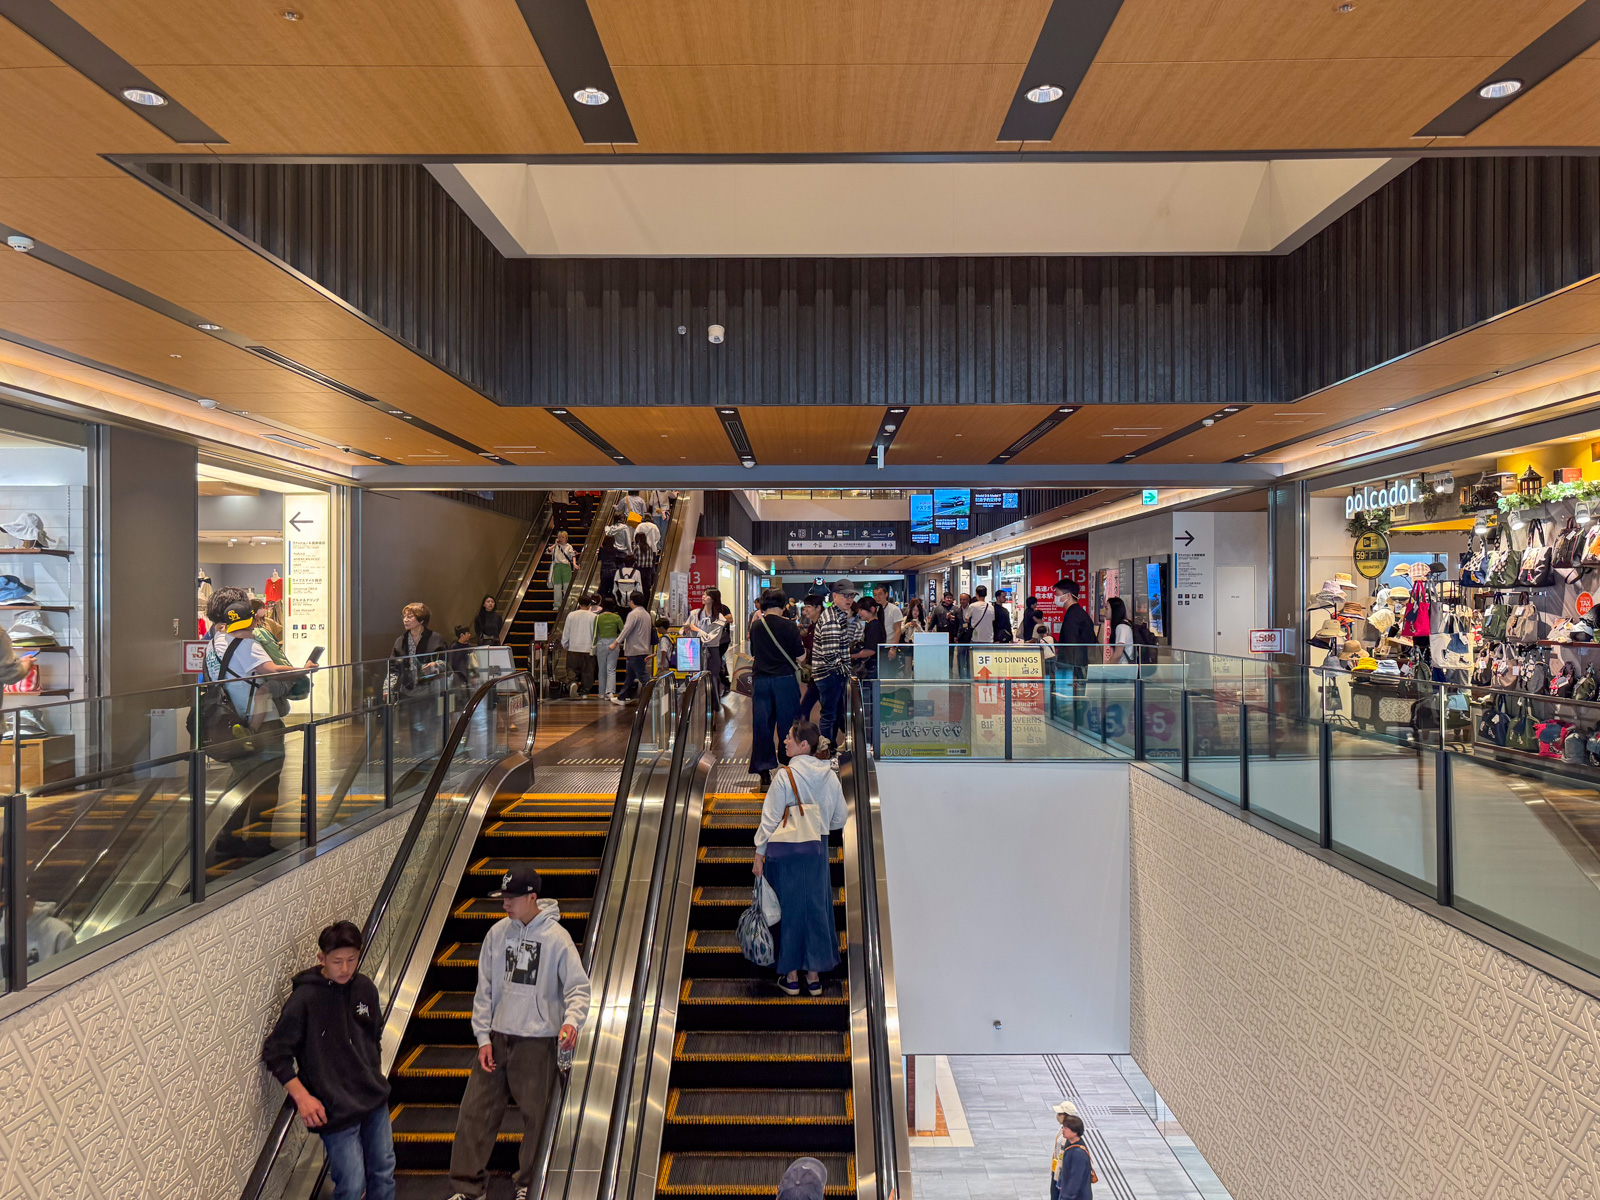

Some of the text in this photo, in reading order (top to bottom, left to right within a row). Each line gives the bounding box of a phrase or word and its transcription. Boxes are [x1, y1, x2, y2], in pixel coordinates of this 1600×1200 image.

[1345, 479, 1417, 519] polcadot
[1055, 568, 1086, 583] 1-13
[978, 655, 1039, 665] 3F 10 DININGS
[981, 720, 994, 729] B1F
